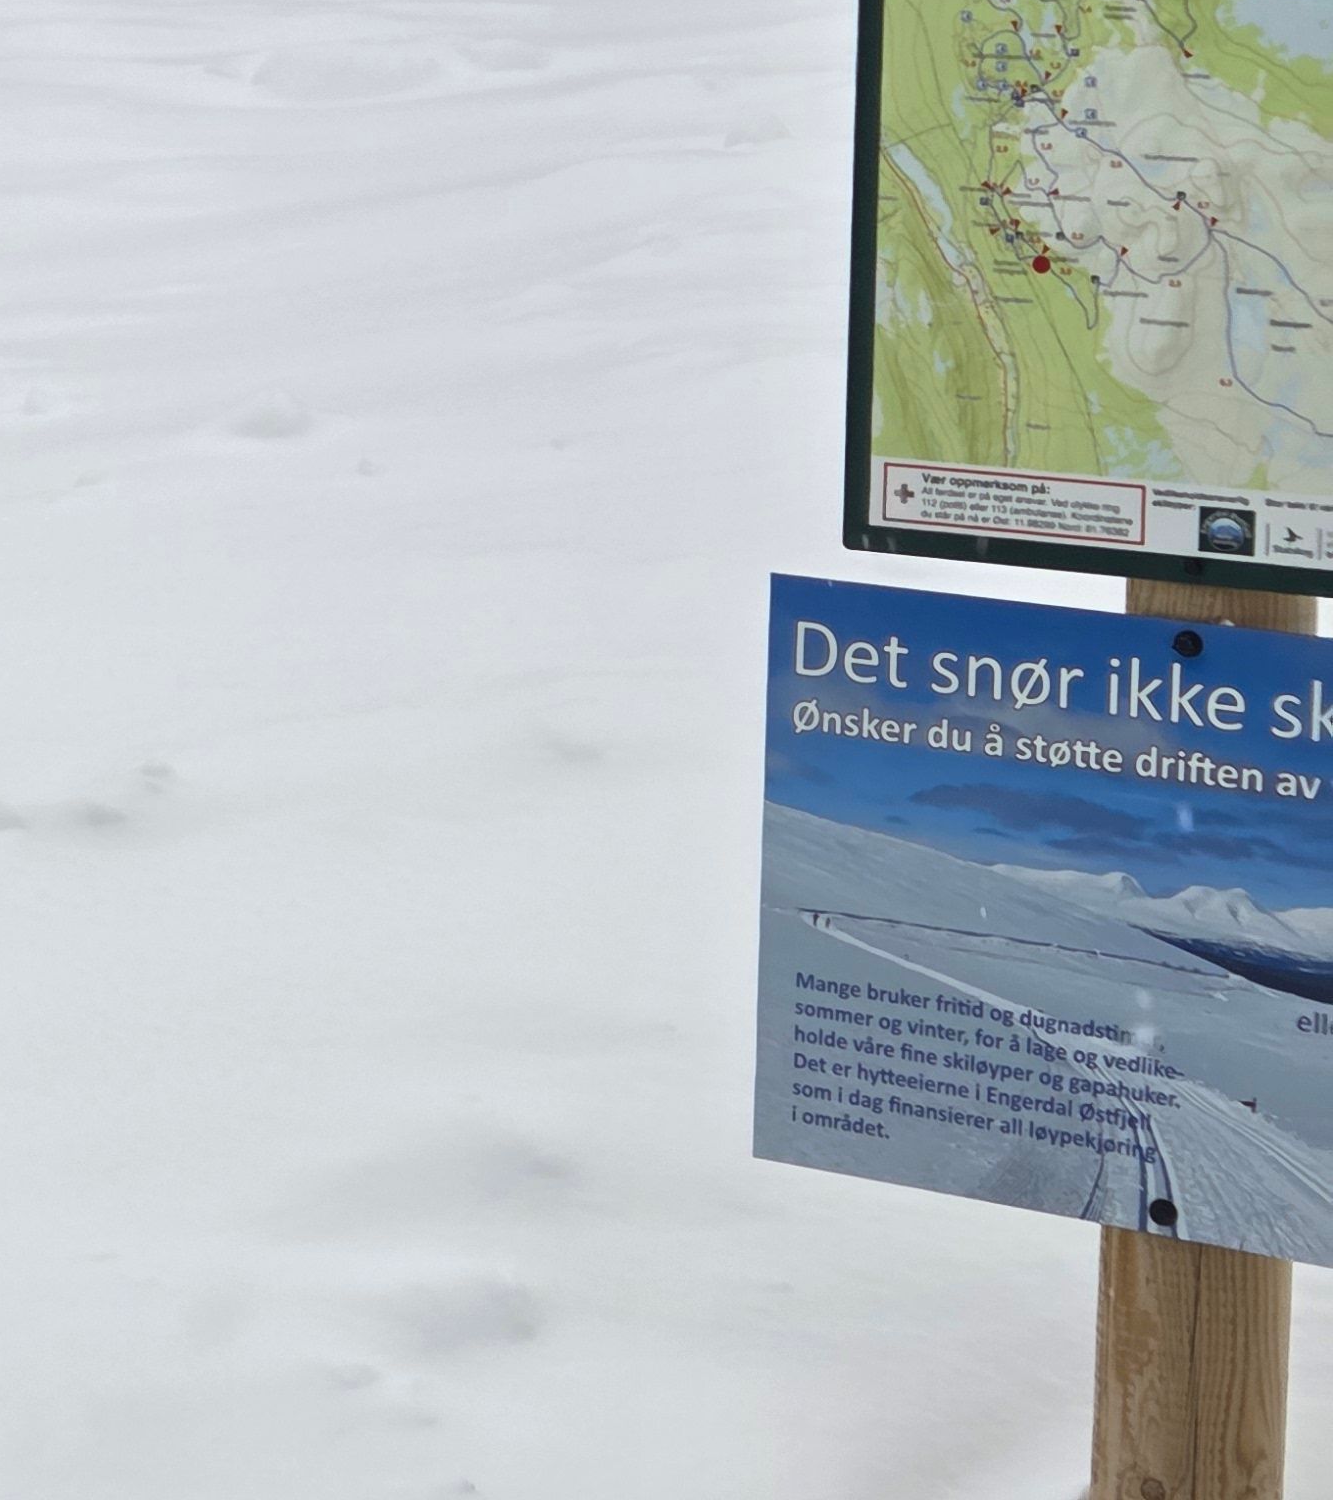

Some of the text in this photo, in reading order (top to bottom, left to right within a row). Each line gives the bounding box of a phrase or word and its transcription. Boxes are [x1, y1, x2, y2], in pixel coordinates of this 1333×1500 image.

[795, 620, 1333, 742] Det snør ikke sk
[793, 699, 1321, 800] Ønsker du å støtte driften av
[795, 972, 861, 1000] Mange
[867, 982, 930, 1009] bruker
[936, 994, 984, 1018] fritid
[990, 1007, 1014, 1027] og
[1297, 1011, 1333, 1035] ell
[794, 1024, 1181, 1109] holde våre fine skiløyper og gapahuker.
[795, 1001, 1184, 1079] sommer og vinter, for å lage og vedlike-
[792, 1105, 890, 1139] i området.
[792, 1082, 1156, 1164] som i dag finansierer all løypekjøring
[794, 1052, 1151, 1131] Det er hytteeierne i Engerdal Østfjell
